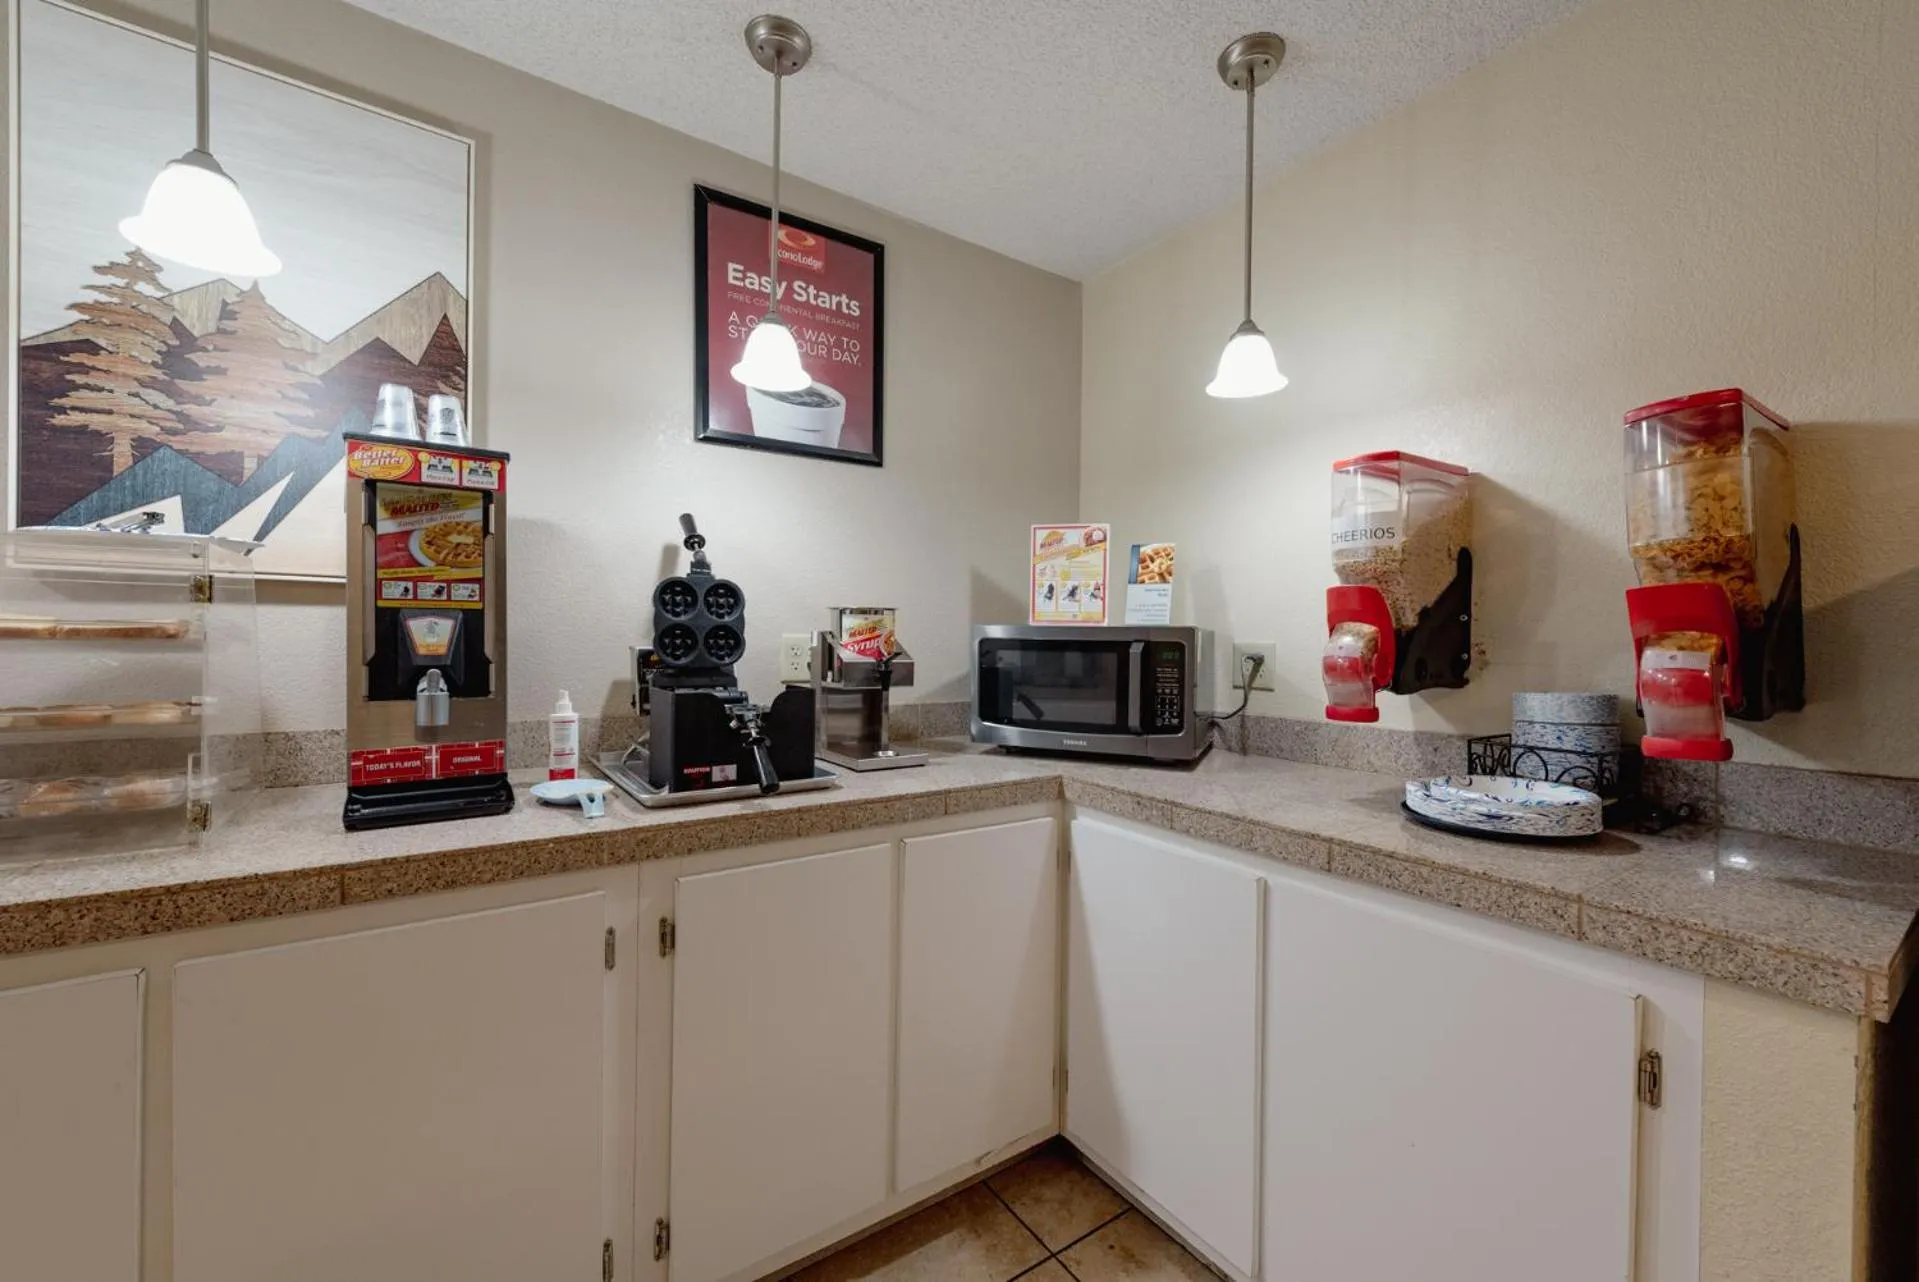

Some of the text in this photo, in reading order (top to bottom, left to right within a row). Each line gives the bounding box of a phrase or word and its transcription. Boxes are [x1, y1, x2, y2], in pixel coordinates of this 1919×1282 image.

[777, 249, 824, 270] conoLodge
[727, 262, 860, 317] Easy Starts
[727, 291, 752, 304] FREE
[729, 311, 860, 352] A WAY TO
[797, 340, 862, 367] OUR DAY.
[1331, 527, 1396, 545] CHEERIOS
[366, 759, 421, 771] TODAY'S FLAVOR
